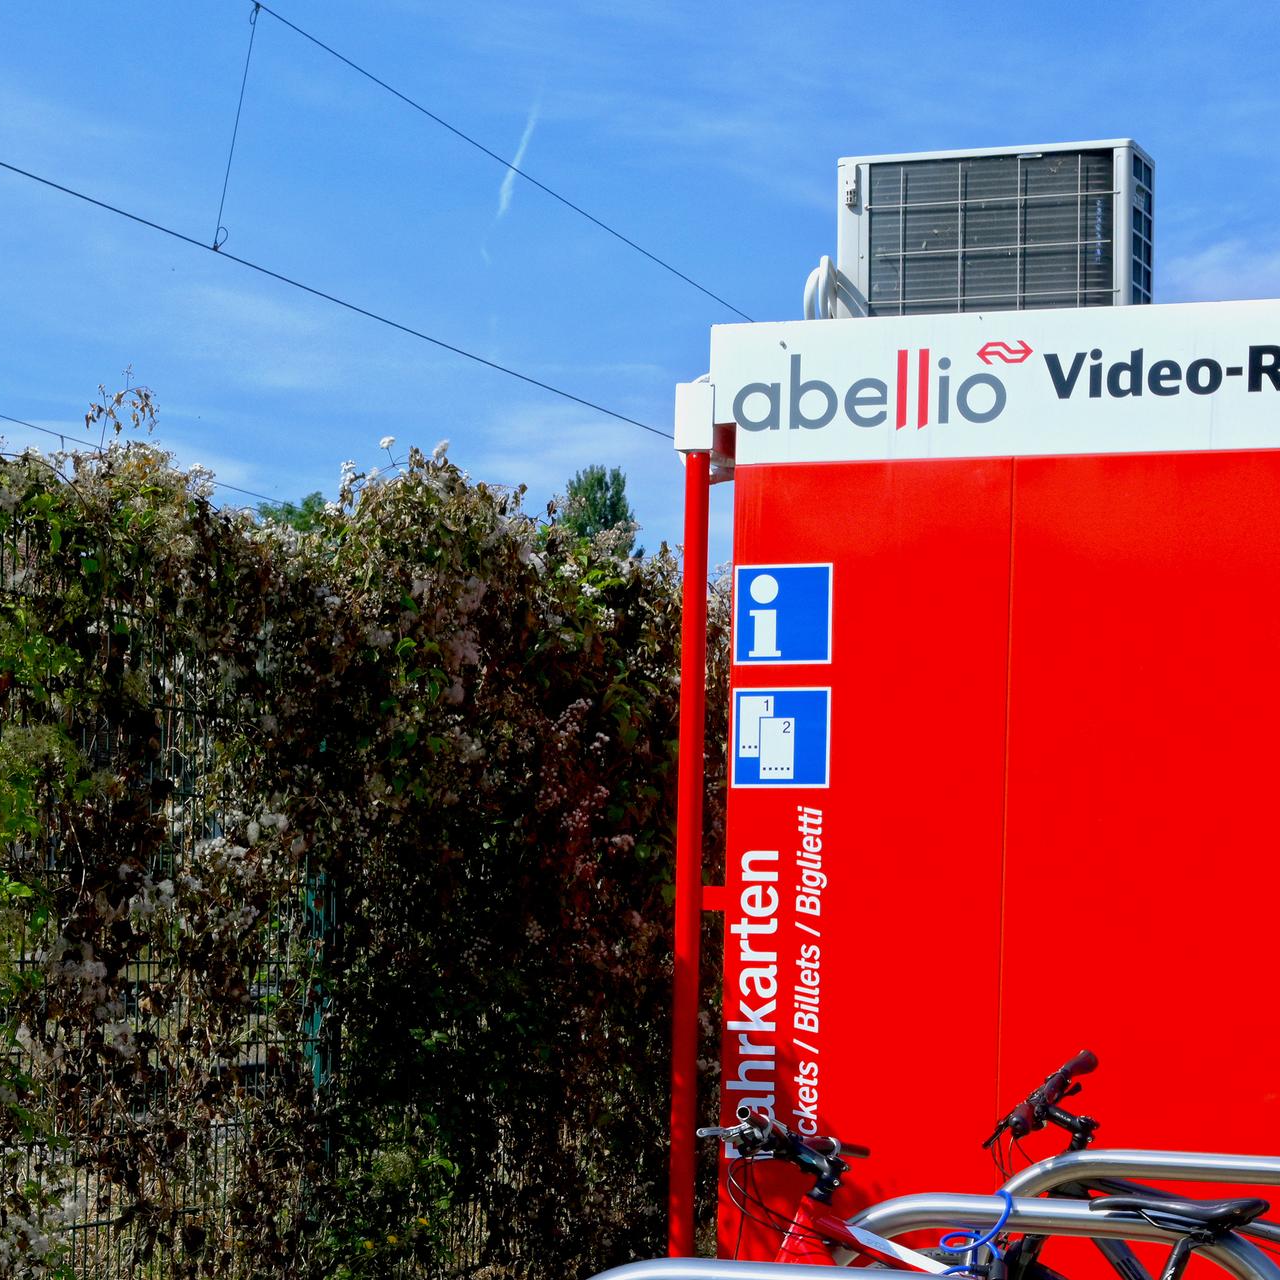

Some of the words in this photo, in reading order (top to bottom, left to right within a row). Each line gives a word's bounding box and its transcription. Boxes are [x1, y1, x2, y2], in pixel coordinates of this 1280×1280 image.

[732, 348, 1007, 432] abellio
[795, 805, 828, 916] Biglietti
[725, 850, 779, 1158] ahrkarten
[793, 943, 821, 1033] Billets
[792, 1060, 819, 1135] ckets
